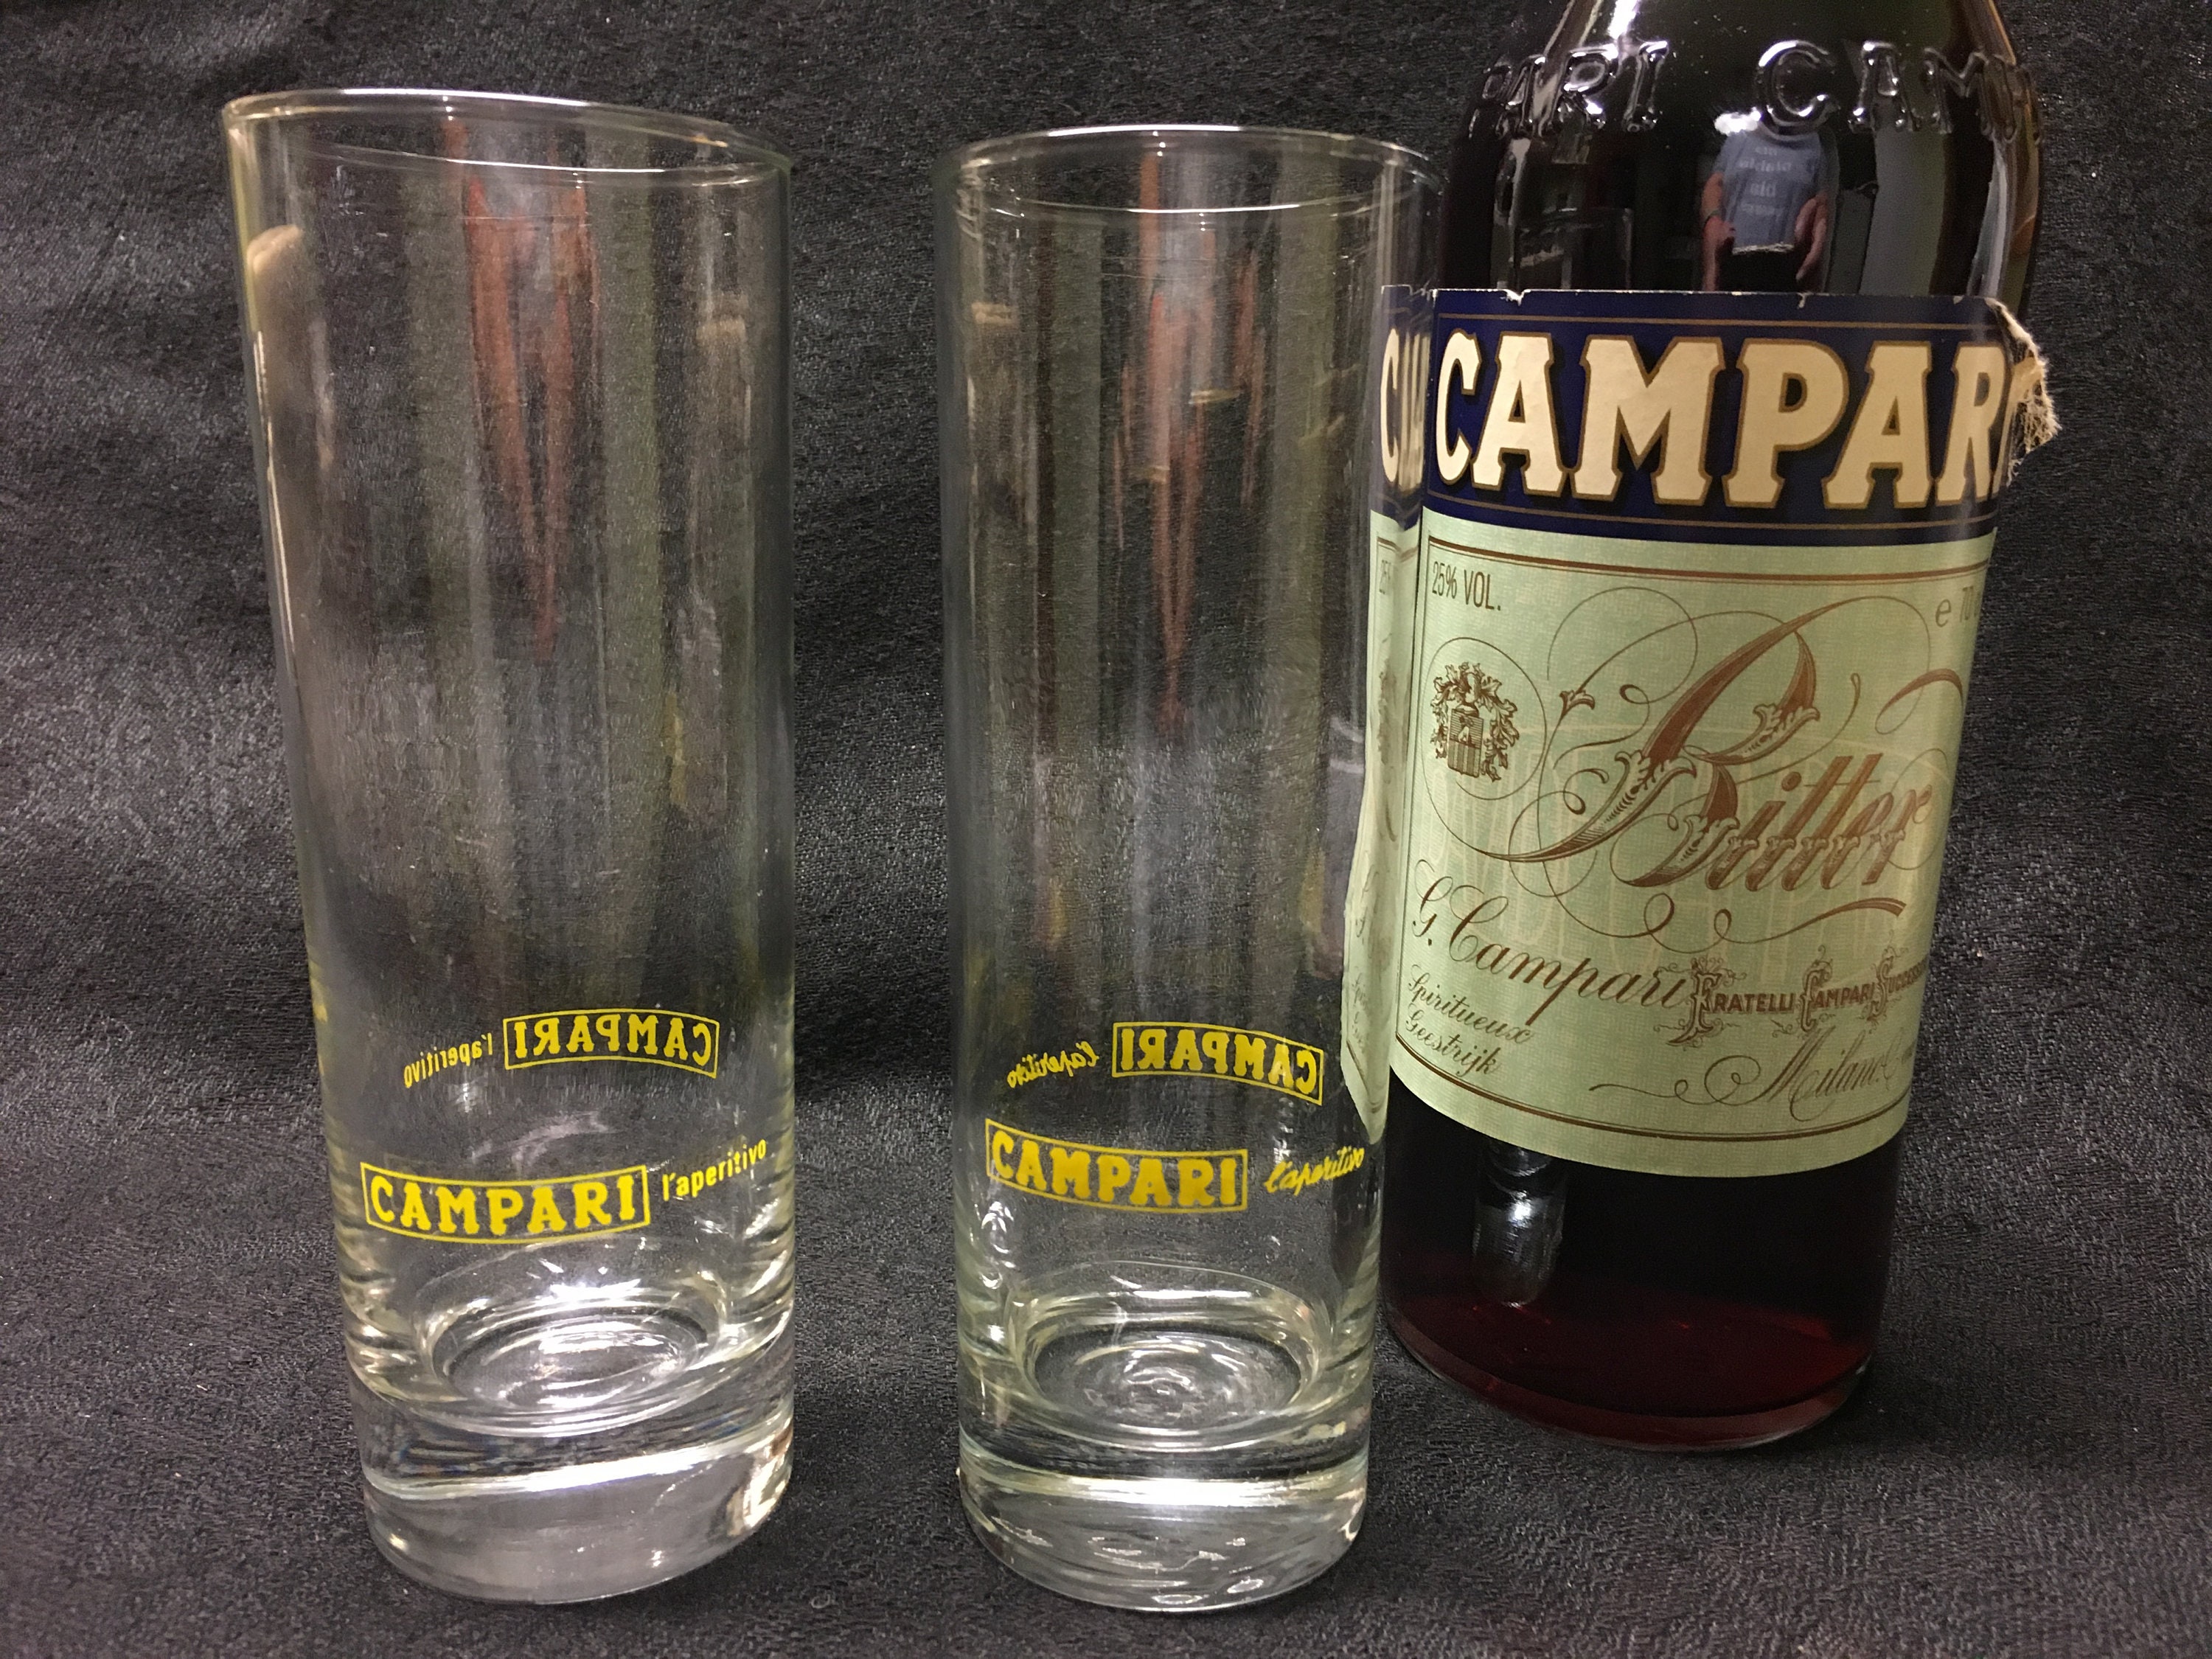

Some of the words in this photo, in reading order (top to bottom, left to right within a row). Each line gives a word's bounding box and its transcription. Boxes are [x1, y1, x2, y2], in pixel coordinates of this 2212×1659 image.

[1756, 40, 2042, 145] CAM
[1435, 328, 2014, 509] CAMPAR
[1432, 560, 1458, 599] 25%
[1464, 568, 1502, 611] VOL.
[1935, 599, 1952, 628] e
[1414, 859, 1454, 947] G.
[1450, 885, 1690, 1026] Campari
[1405, 1002, 1503, 1077] Geestrijk
[1408, 964, 1534, 1044] Spiritueux
[1668, 959, 1795, 1046] FRATELLI
[1796, 956, 1876, 1034] CAMPARI
[370, 1174, 636, 1236] CAMPARI
[661, 1138, 768, 1202] l'aperitivo
[992, 1130, 1237, 1207] CAMPARI
